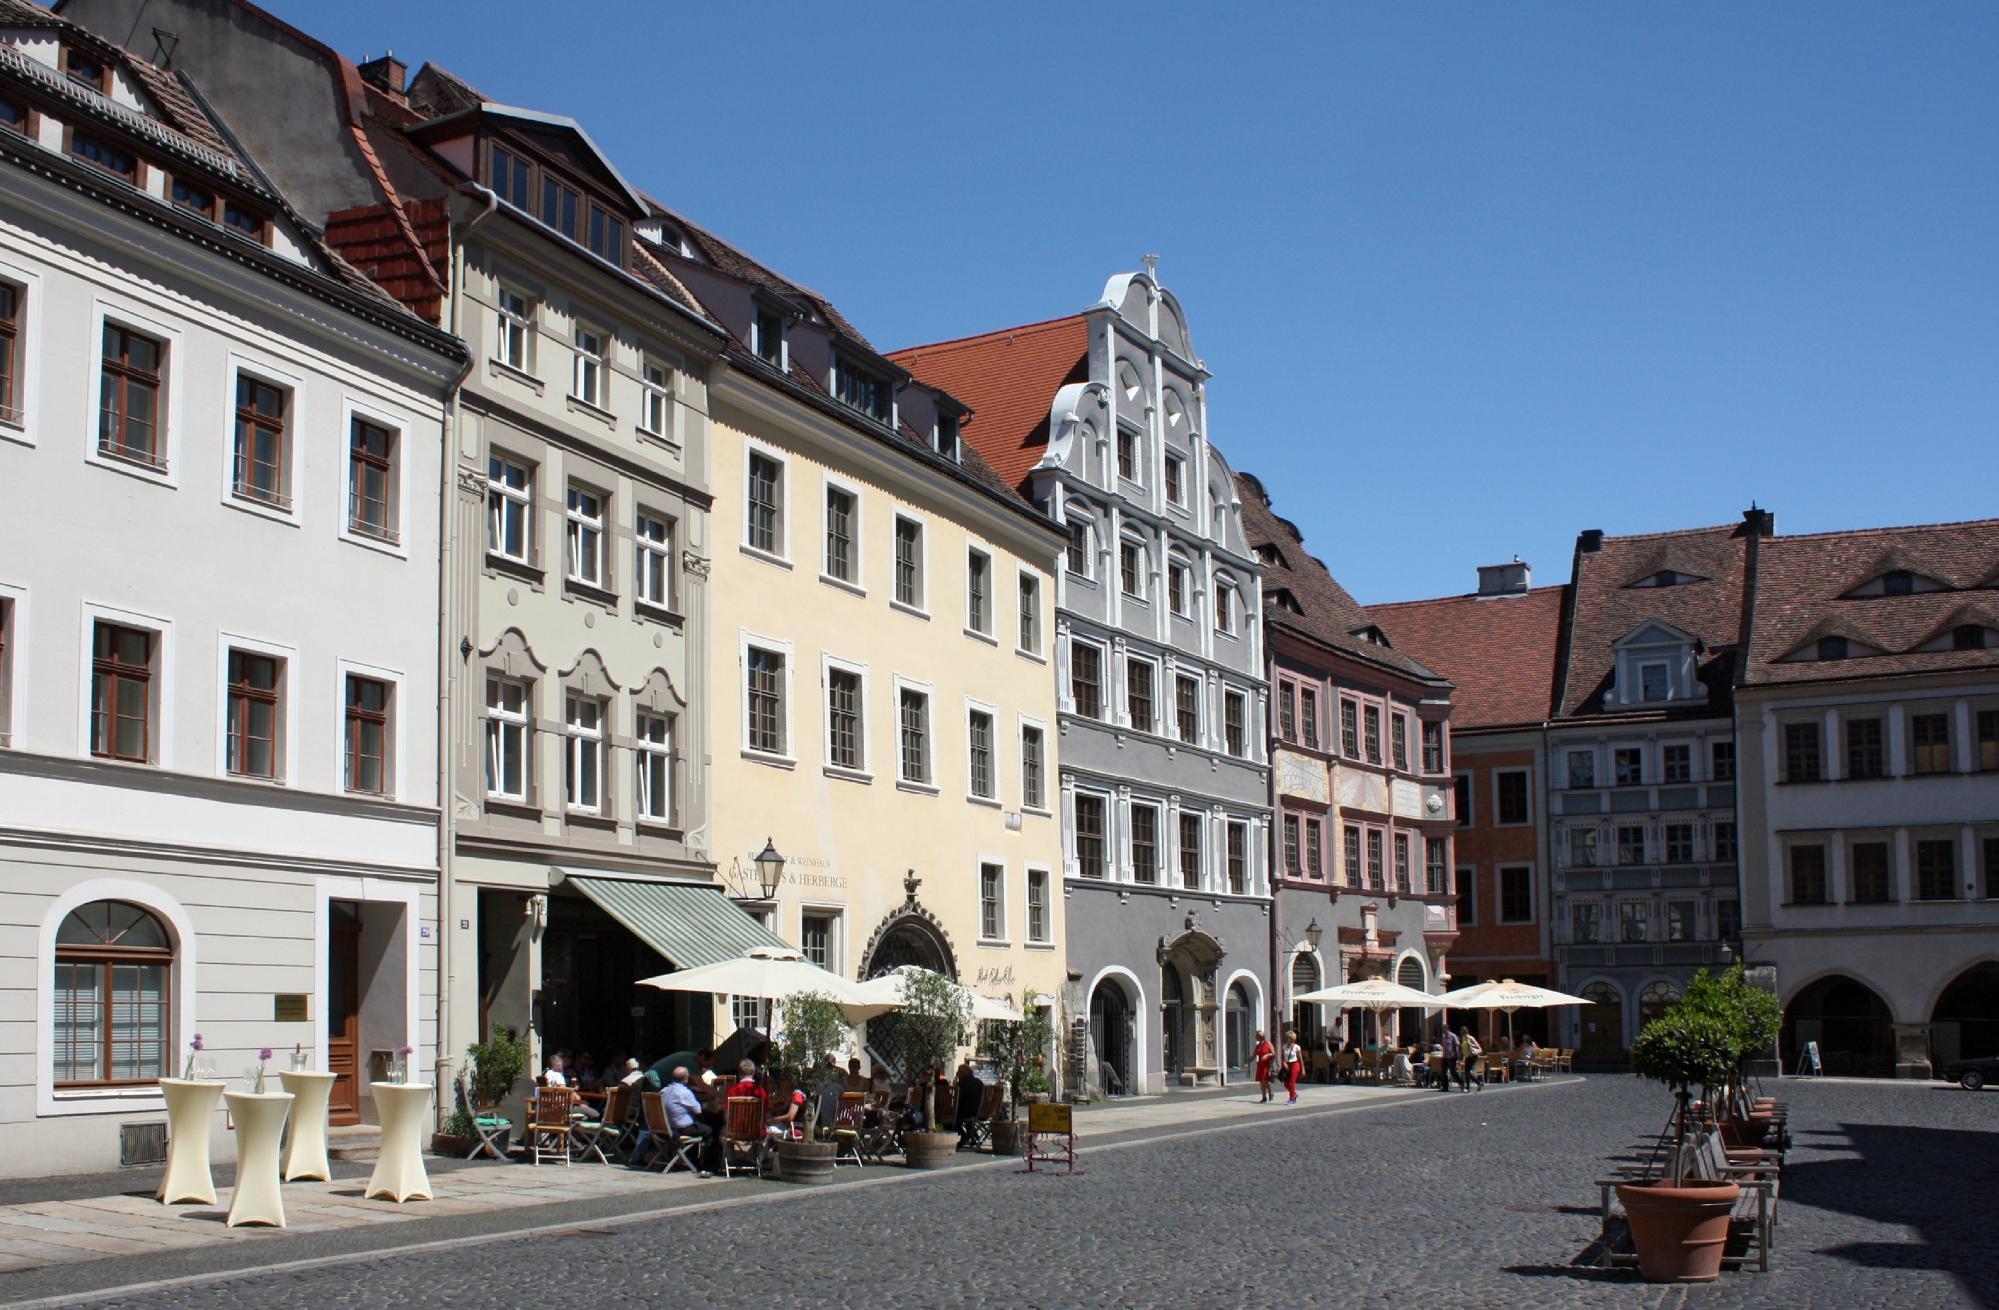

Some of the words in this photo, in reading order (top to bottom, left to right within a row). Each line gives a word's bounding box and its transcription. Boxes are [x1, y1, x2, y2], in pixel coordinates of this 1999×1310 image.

[729, 867, 786, 884] GSTES
[789, 871, 797, 885] &
[799, 873, 848, 889] HERBERGE
